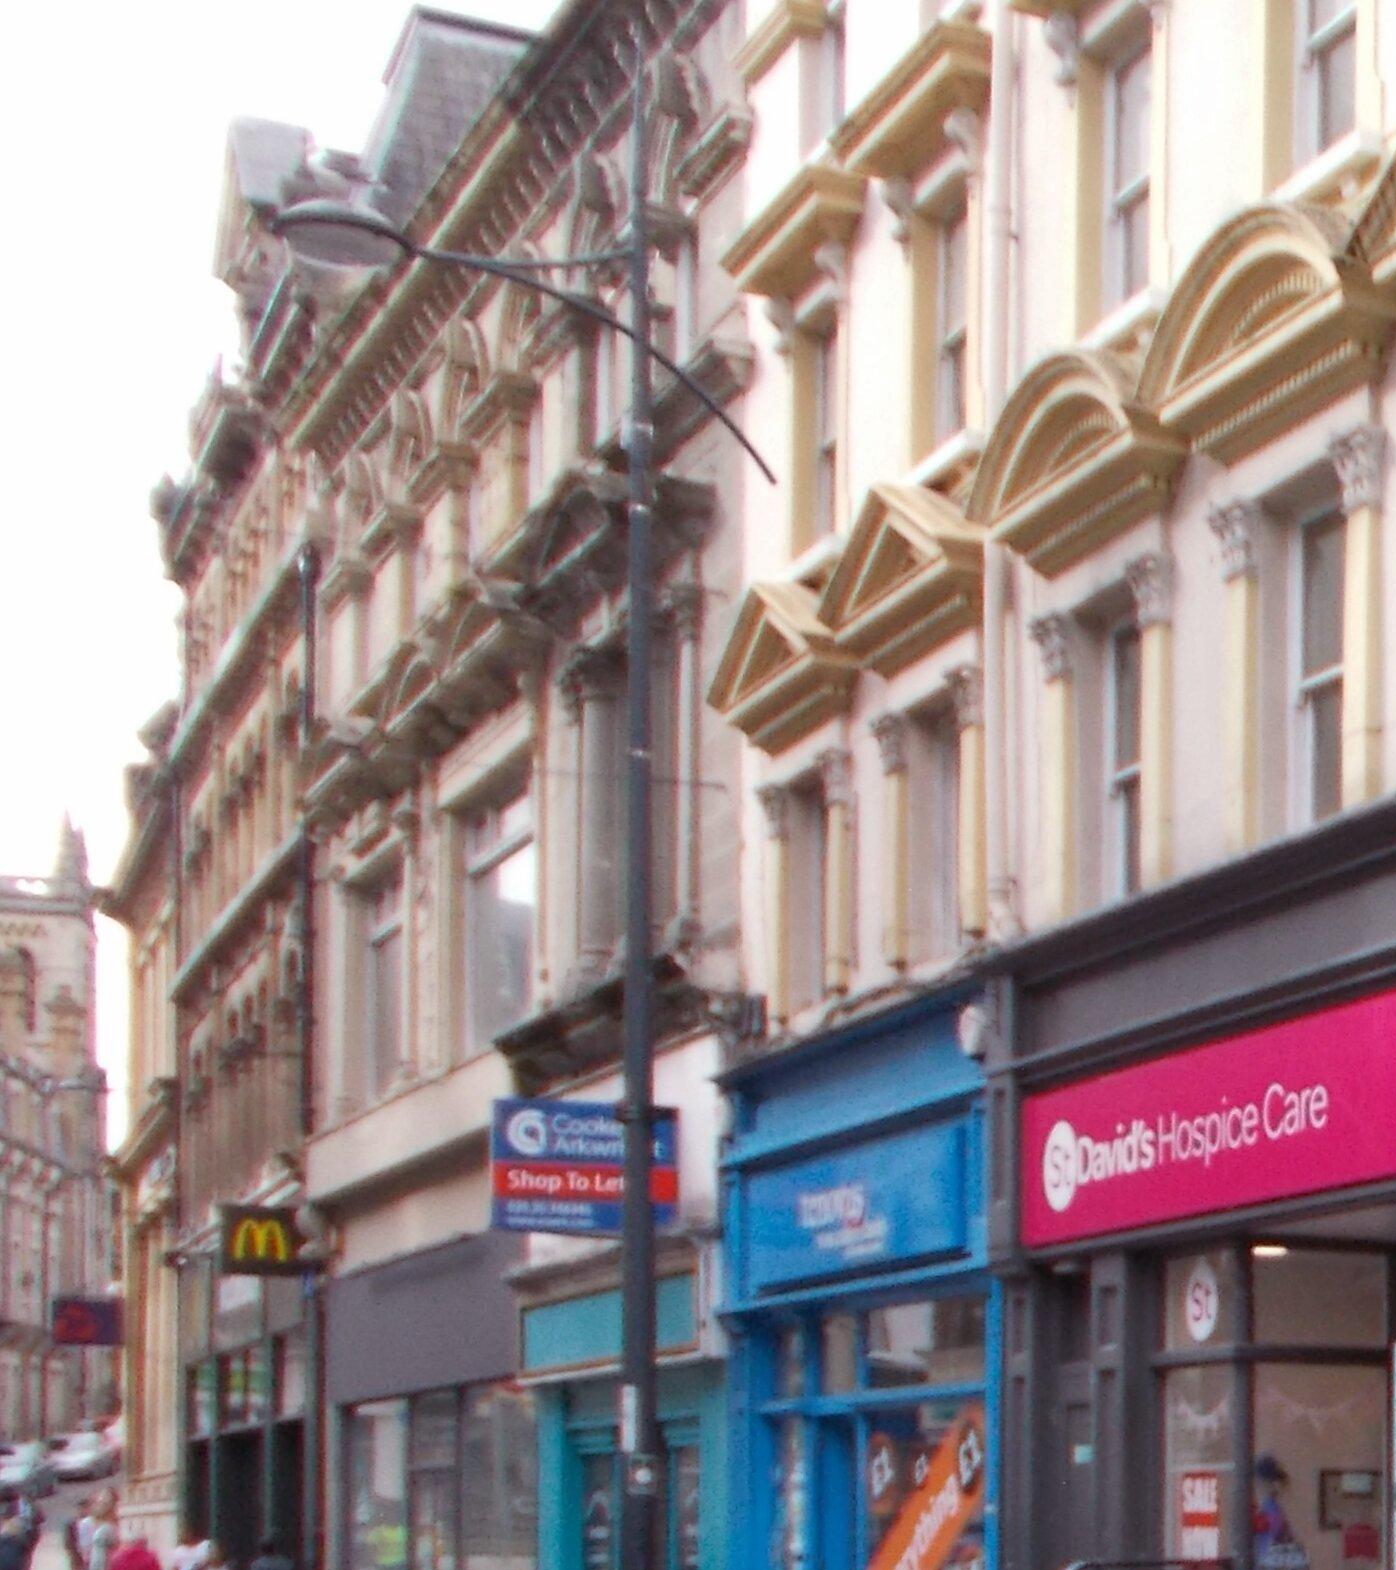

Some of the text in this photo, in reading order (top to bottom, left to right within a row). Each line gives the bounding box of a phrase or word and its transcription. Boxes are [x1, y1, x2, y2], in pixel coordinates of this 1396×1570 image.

[1049, 1081, 1329, 1190] St David's Hospice Care
[506, 1169, 563, 1195] Shop
[567, 1170, 590, 1191] To
[1191, 1281, 1213, 1322] St
